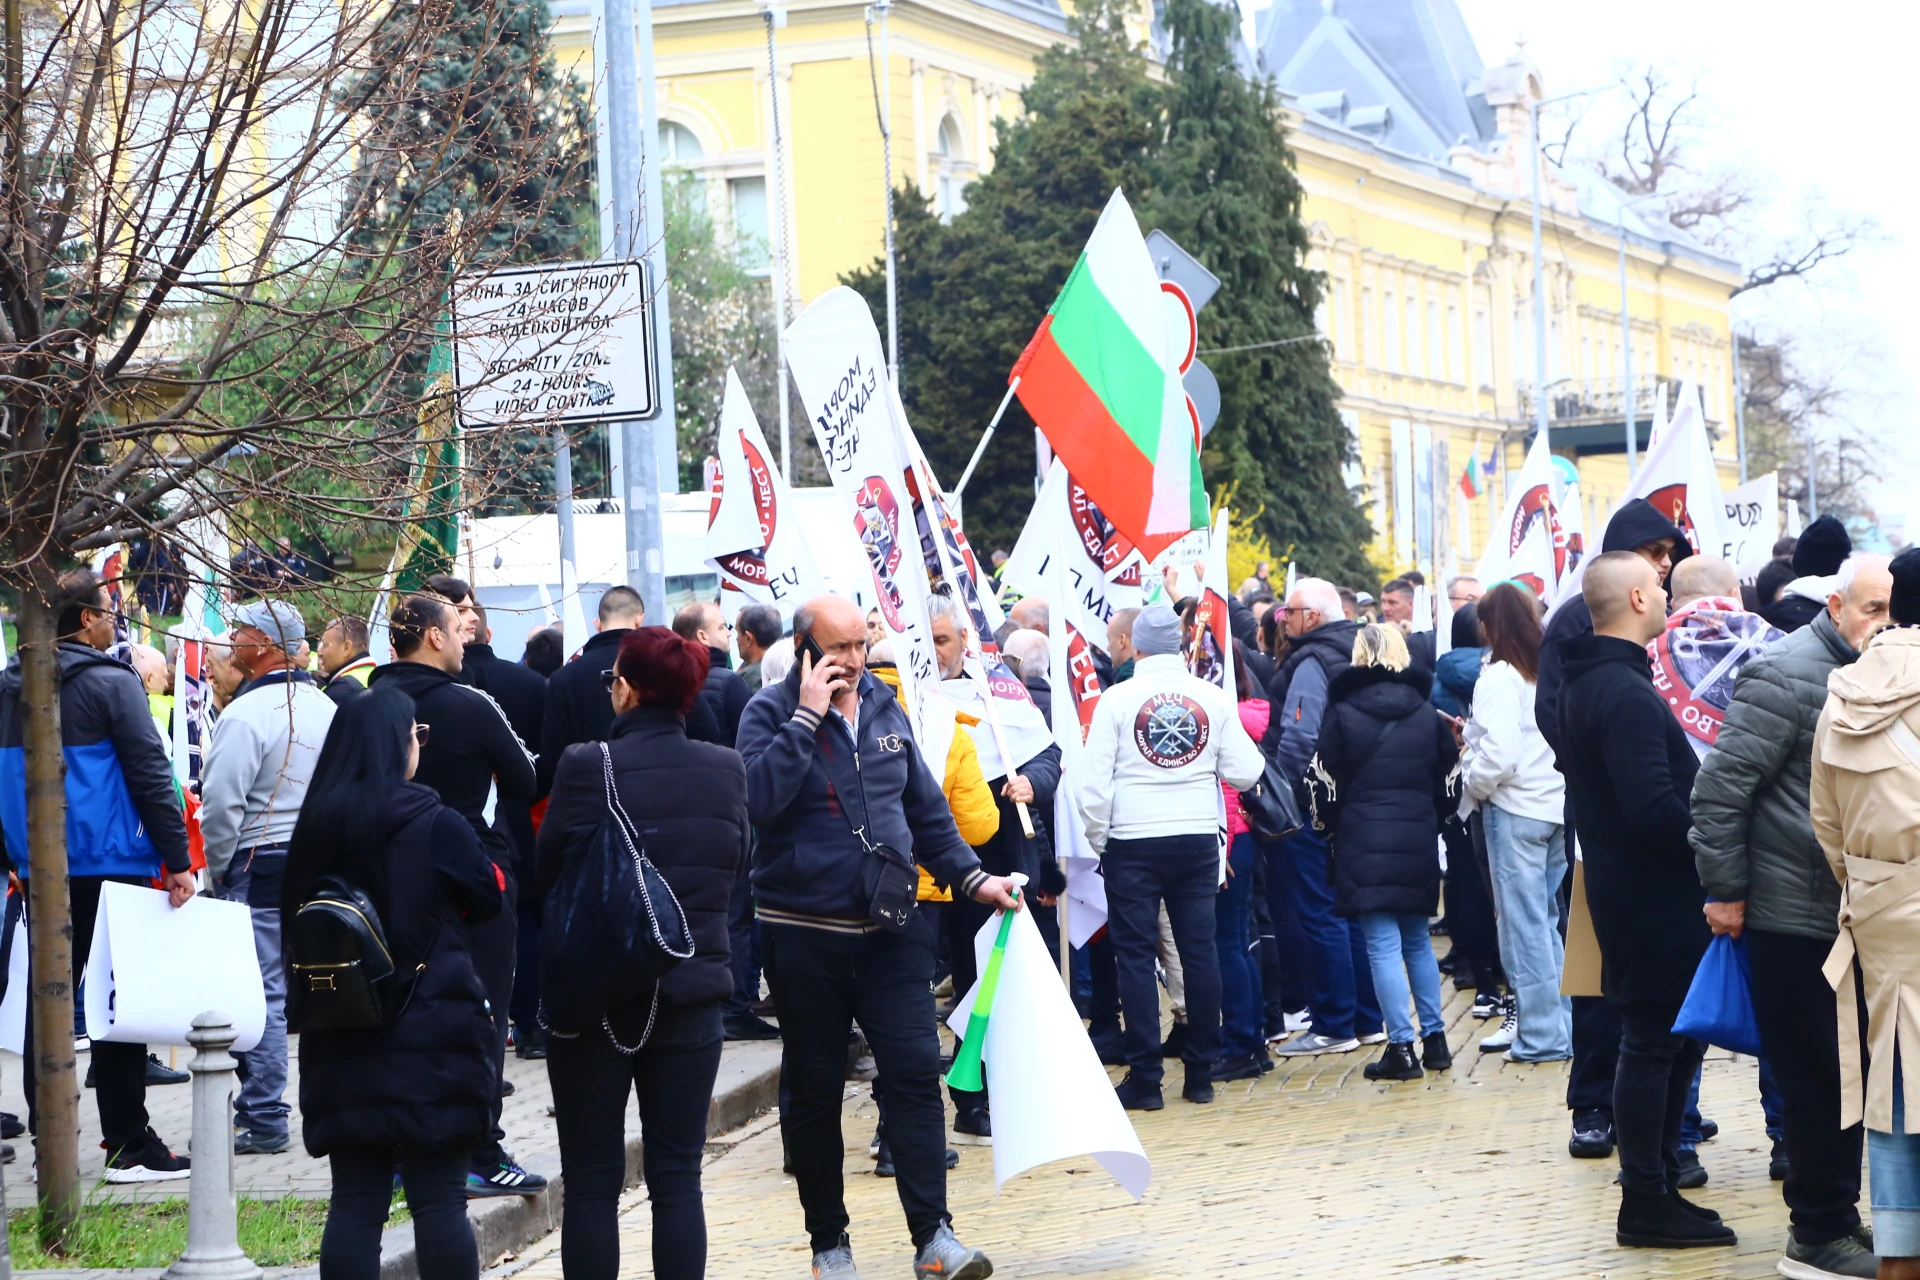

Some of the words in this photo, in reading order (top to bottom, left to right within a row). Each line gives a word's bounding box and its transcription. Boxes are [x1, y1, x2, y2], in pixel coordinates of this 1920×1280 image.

[464, 283, 504, 301] ЗОНА
[513, 281, 531, 297] ЗА
[540, 272, 629, 295] СИГУРНОСТ
[488, 354, 562, 375] SECURITY
[495, 397, 539, 415] VIDEO
[752, 466, 772, 508] ЧЕСТ
[1152, 693, 1184, 707] МЕЧ
[1136, 729, 1154, 758] МОРАЛ
[1157, 749, 1198, 767] ЕДИНСТВО
[1198, 723, 1208, 745] ЧЕСТ
